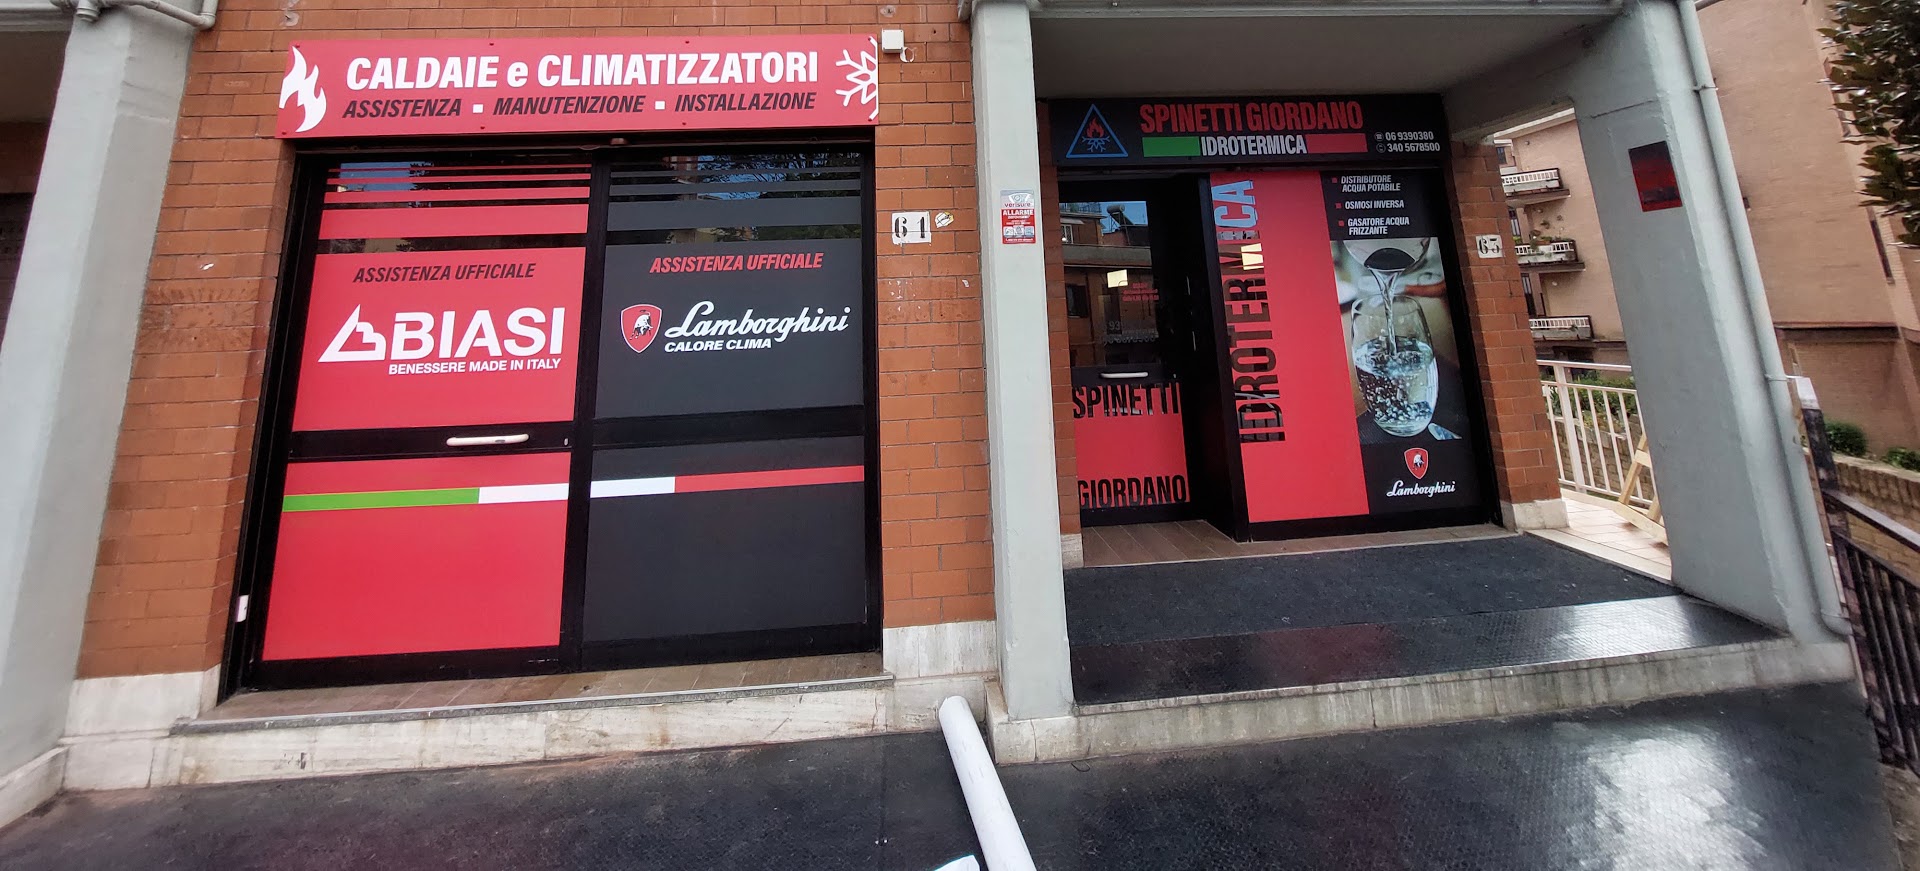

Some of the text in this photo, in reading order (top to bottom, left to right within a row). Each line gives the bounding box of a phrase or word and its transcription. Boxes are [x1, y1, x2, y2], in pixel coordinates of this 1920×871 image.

[346, 51, 818, 90] CALDAIE e CLIMATIZZATORI
[342, 92, 817, 118] ASSISTENZA MANUTENZIONE INSTALLAZIONE
[1140, 101, 1364, 133] SPINETTI GIORDANO
[1201, 135, 1307, 156] IDROTERMICA
[1385, 131, 1434, 141] 06 9390380
[1387, 142, 1440, 152] 340 5678500
[1341, 175, 1392, 184] DISTRIBUTORE
[1342, 183, 1401, 193] ACQUA POTABILE
[1345, 200, 1404, 210] OSMOSI INVERSA
[895, 217, 926, 239] 61
[1347, 217, 1410, 227] GASATORE ACQUA
[1349, 226, 1388, 235] FRIZZANTE
[353, 263, 536, 283] ASSISTENZA UFFICIALE
[650, 253, 824, 273] ASSISTENZA UFFICIALE
[664, 300, 851, 343] Lamborghini
[1210, 179, 1286, 444] IDROTERMICA
[390, 306, 566, 360] BIASI
[664, 338, 772, 353] CALORE CLIMA
[388, 358, 561, 375] BENESSERE MADE IN ITALY
[1072, 382, 1179, 419] SPINETTI
[1078, 475, 1187, 508] GIORDANO
[1386, 479, 1456, 498] Lamborghini
